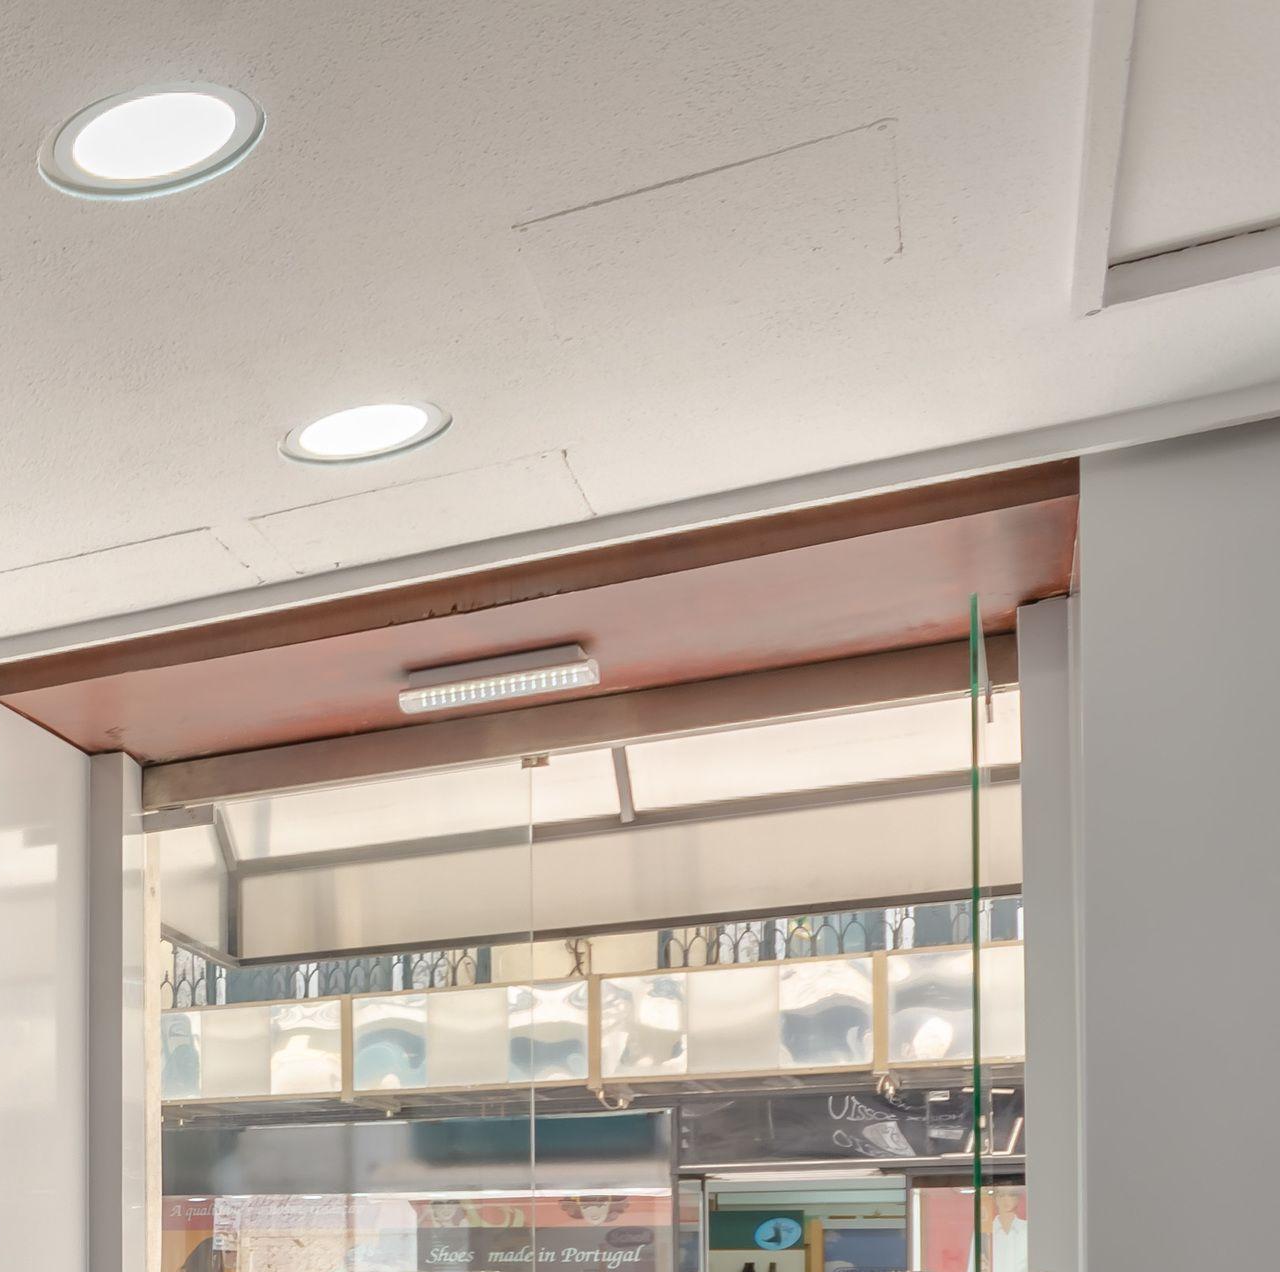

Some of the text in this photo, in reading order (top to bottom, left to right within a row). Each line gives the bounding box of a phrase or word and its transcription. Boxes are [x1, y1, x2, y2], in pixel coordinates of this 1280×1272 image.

[425, 1244, 646, 1269] Shoes made in Portugal
